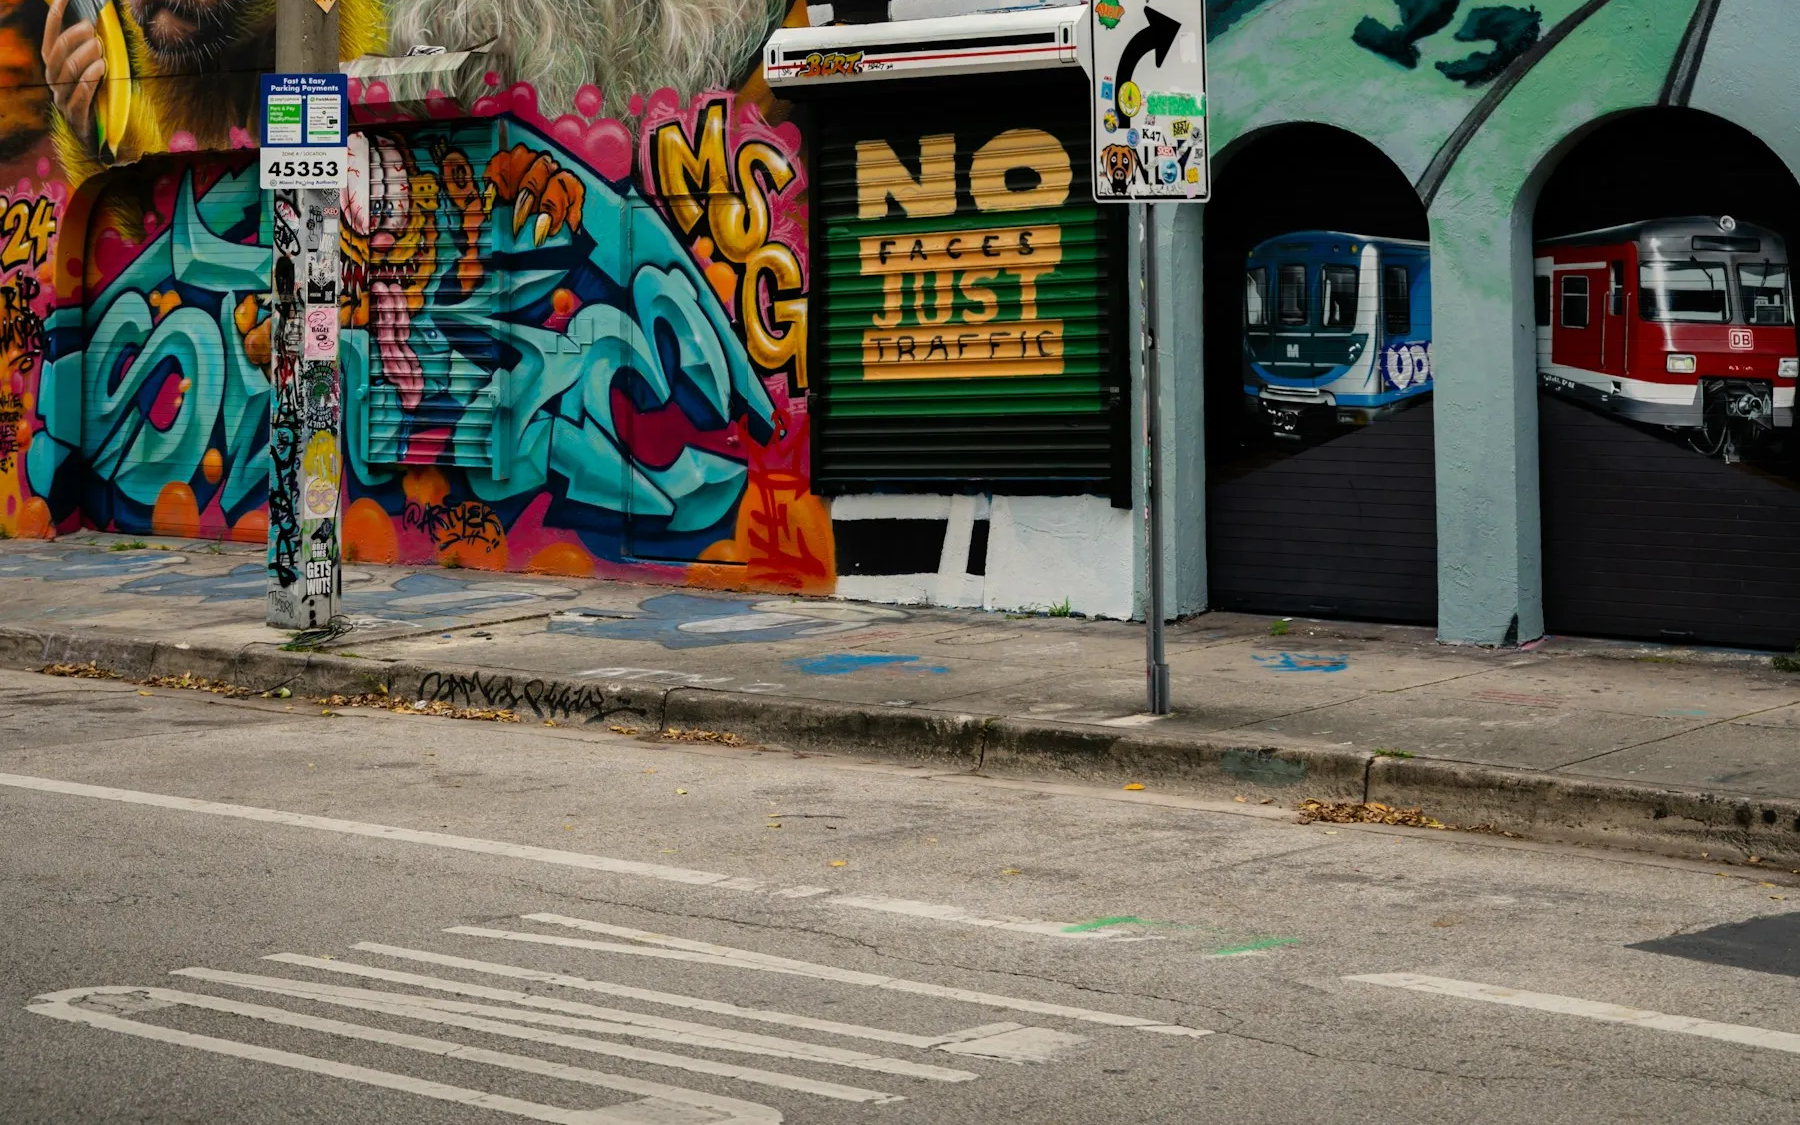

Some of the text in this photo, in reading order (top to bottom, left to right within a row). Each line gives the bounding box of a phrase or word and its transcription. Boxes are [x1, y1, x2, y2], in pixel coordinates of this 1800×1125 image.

[270, 85, 339, 93] Parking Payments
[283, 77, 326, 86] Fast & Easy
[1142, 128, 1161, 142] K47
[267, 161, 339, 177] 45353
[854, 127, 1074, 220] NO
[878, 230, 1035, 265] FACES
[871, 261, 1056, 329] JUST
[869, 329, 1055, 363] TRAFFIC
[1732, 333, 1751, 346] DB
[306, 560, 332, 579] GETS
